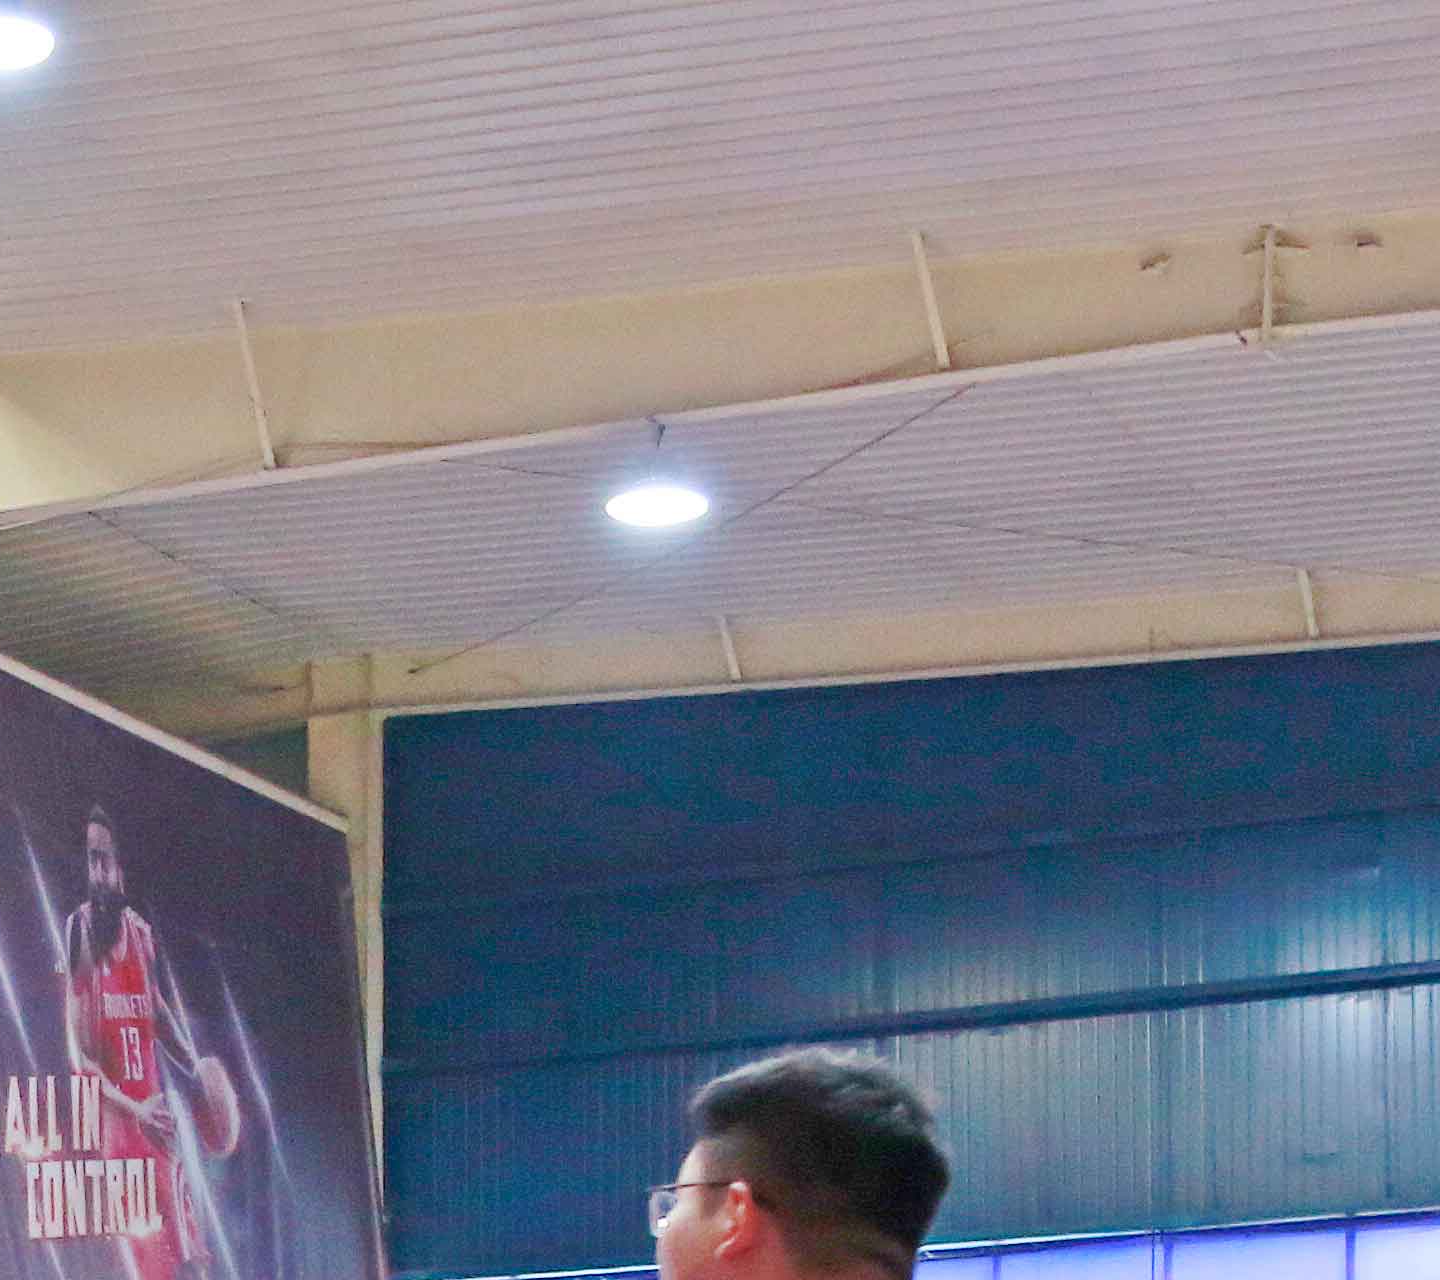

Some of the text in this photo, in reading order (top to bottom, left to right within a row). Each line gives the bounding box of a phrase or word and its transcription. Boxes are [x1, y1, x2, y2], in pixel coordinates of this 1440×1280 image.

[4, 1075, 101, 1157] ALL IN
[25, 1158, 163, 1238] CONTROL
